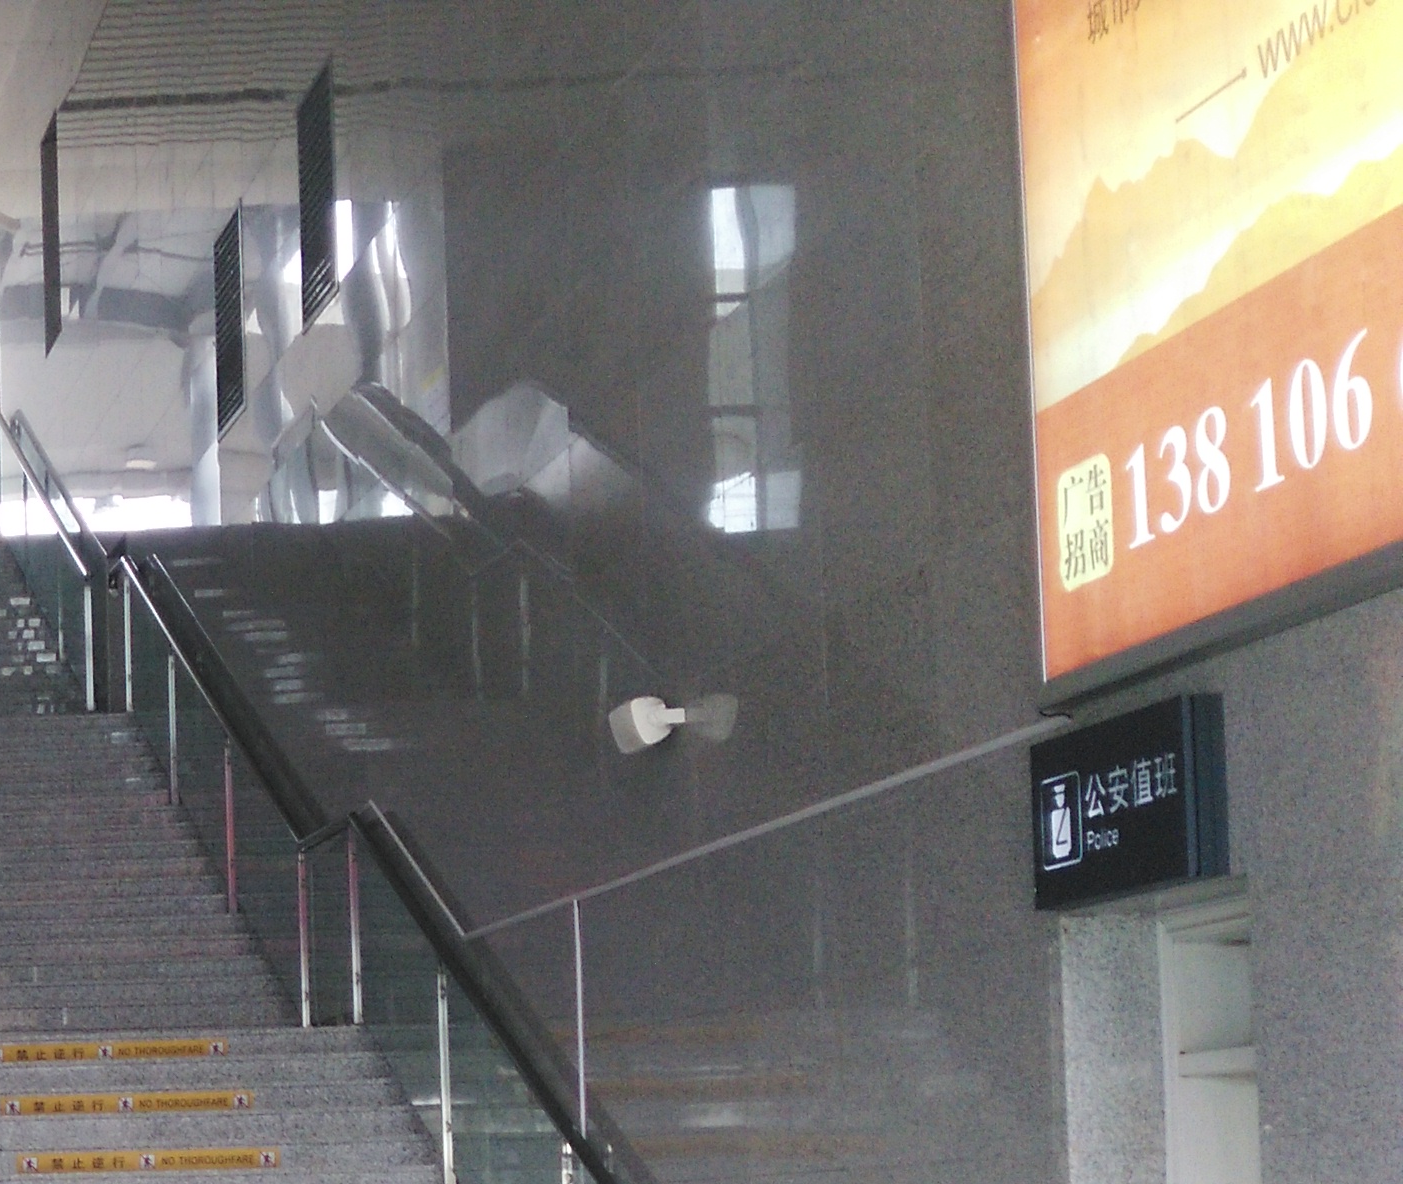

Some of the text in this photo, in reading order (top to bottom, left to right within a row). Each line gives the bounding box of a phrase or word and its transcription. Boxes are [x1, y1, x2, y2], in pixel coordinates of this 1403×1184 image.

[1124, 405, 1232, 550] 138
[1250, 327, 1373, 493] 106
[1085, 752, 1178, 819] 公安值班
[1086, 828, 1120, 851] Police
[16, 1047, 85, 1061] 禁止逆行
[118, 1048, 131, 1056] NO
[33, 1099, 104, 1113] 禁止逆行
[139, 1096, 228, 1108] NO THOROUGHFARE
[51, 1156, 125, 1170] 禁止逆行
[161, 1154, 255, 1166] NO THOROUGHFARE
